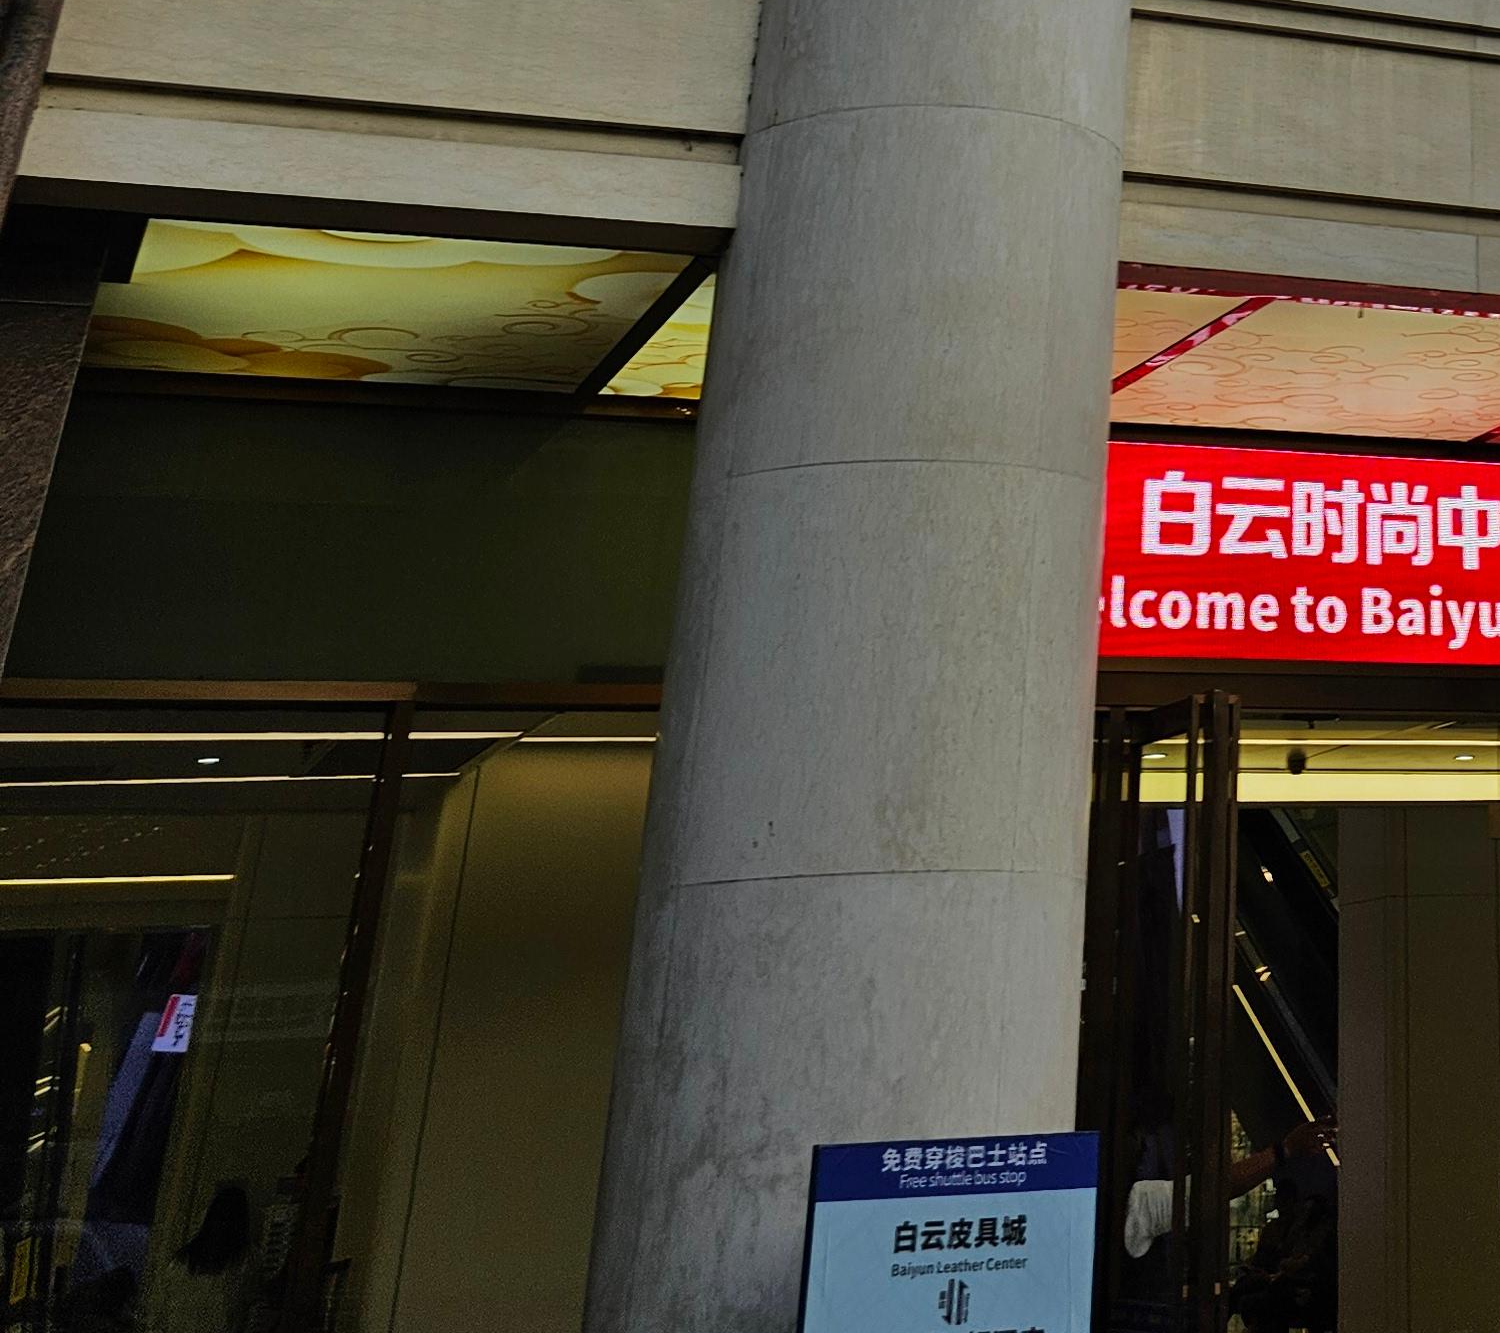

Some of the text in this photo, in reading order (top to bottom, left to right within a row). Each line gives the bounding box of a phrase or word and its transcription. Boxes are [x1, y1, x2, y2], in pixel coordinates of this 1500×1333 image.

[1098, 574, 1279, 631] lcome
[1291, 586, 1348, 634] to
[881, 1140, 1049, 1173] 免费穿梭巴士站点
[899, 1169, 1028, 1189] Free shuttle bus stop
[893, 1214, 1028, 1254] 白云皮具城
[890, 1257, 1029, 1279] Baiyun Leather Center
